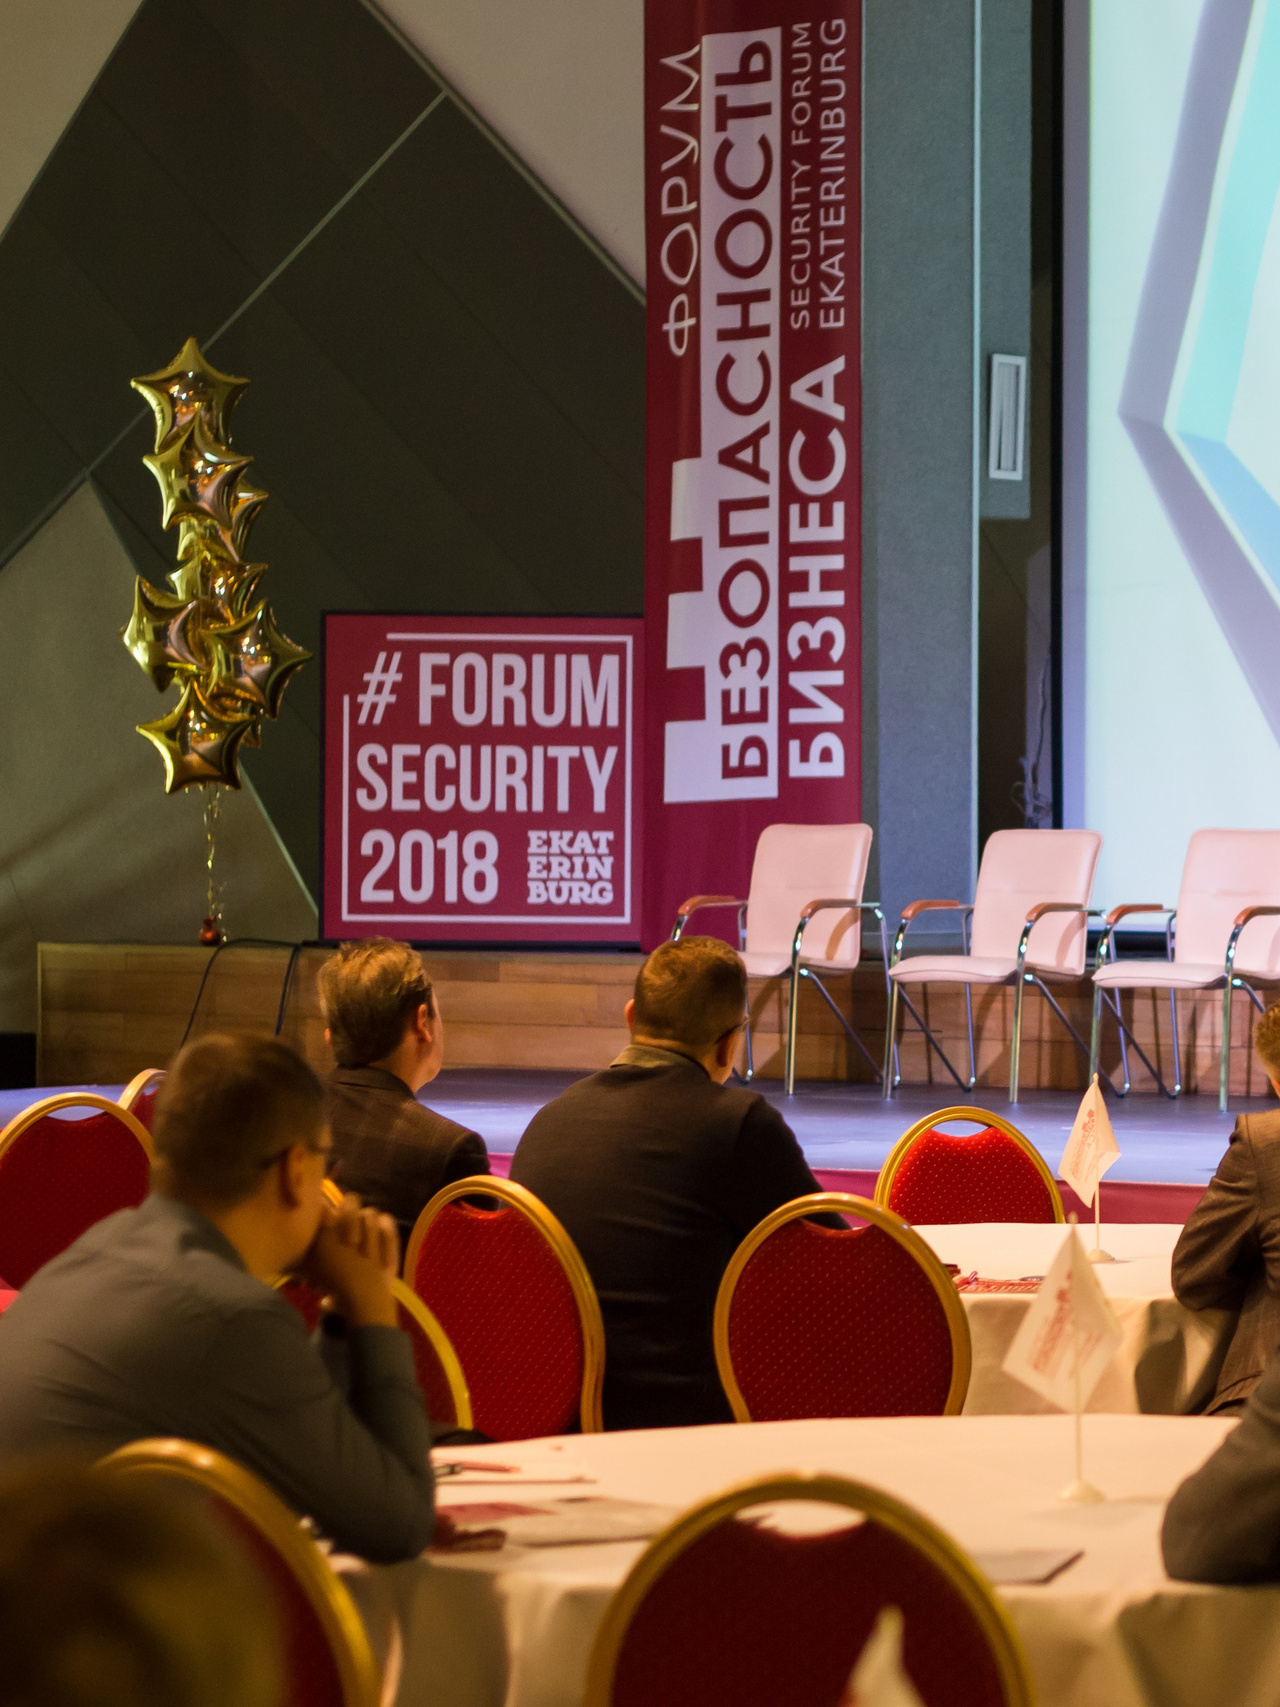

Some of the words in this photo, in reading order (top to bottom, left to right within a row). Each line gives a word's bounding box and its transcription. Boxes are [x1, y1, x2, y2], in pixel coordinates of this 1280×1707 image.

[791, 22, 813, 146] FORUM
[659, 44, 700, 357] ФОРУМ
[819, 18, 847, 329] EKATERINBURG
[790, 160, 812, 330] SECURITY
[713, 40, 774, 780] БЕЗОПАСНОСТЬ
[788, 354, 846, 778] БИЗНЕСА
[418, 652, 620, 728] FORUM
[356, 743, 619, 813] SECURITY
[360, 829, 499, 905] 2018
[526, 830, 615, 854] EKAT
[526, 855, 615, 880] ERIN
[526, 881, 615, 905] BURG
